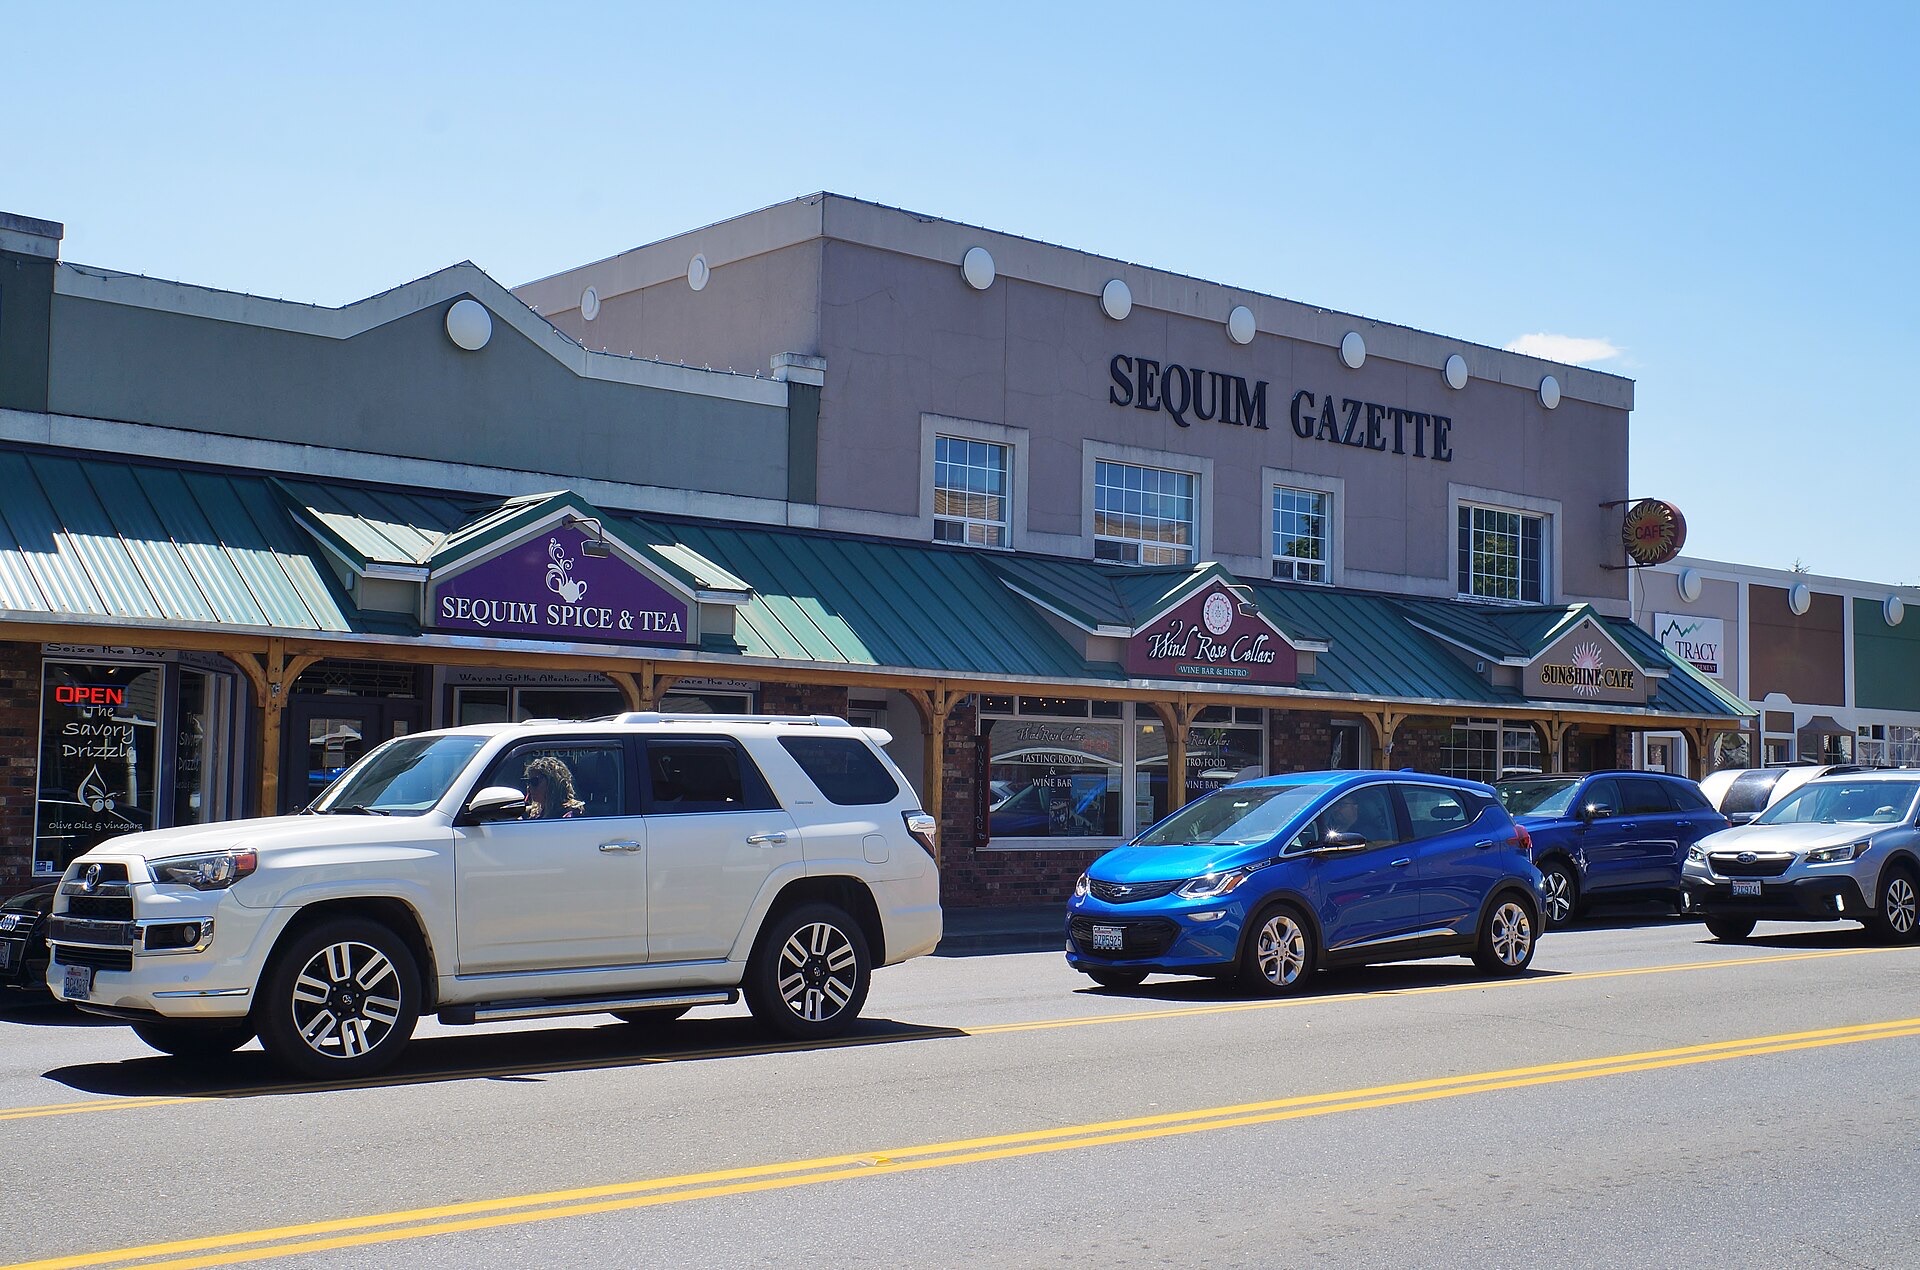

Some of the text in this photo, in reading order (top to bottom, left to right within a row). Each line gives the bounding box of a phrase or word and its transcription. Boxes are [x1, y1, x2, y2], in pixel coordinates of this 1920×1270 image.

[1109, 354, 1453, 463] SEQUIM GAZETTE
[1635, 525, 1665, 540] CAFE
[442, 596, 683, 633] SEQUIM SPICE & TEA
[1148, 620, 1276, 664] Wind Rose Cellars
[46, 643, 166, 657] Seize the Day
[1675, 640, 1718, 661] TRACY
[459, 673, 483, 683] Way
[504, 674, 522, 682] Get
[583, 674, 592, 682] of
[1180, 666, 1247, 677] WINE BAR & BISTRO
[1541, 664, 1634, 689] SUNSHINE CAFE
[55, 686, 122, 704] OPEN
[82, 705, 114, 718] The
[62, 722, 134, 744] Savory
[62, 741, 135, 758] Drizzle
[1021, 754, 1084, 764] TASTING ROOM
[1204, 759, 1226, 767] FOOD
[1049, 767, 1056, 775] &
[1032, 778, 1072, 787] WINE BAR
[1205, 781, 1219, 789] BAR
[48, 821, 72, 829] Olive
[74, 821, 93, 829] Oils
